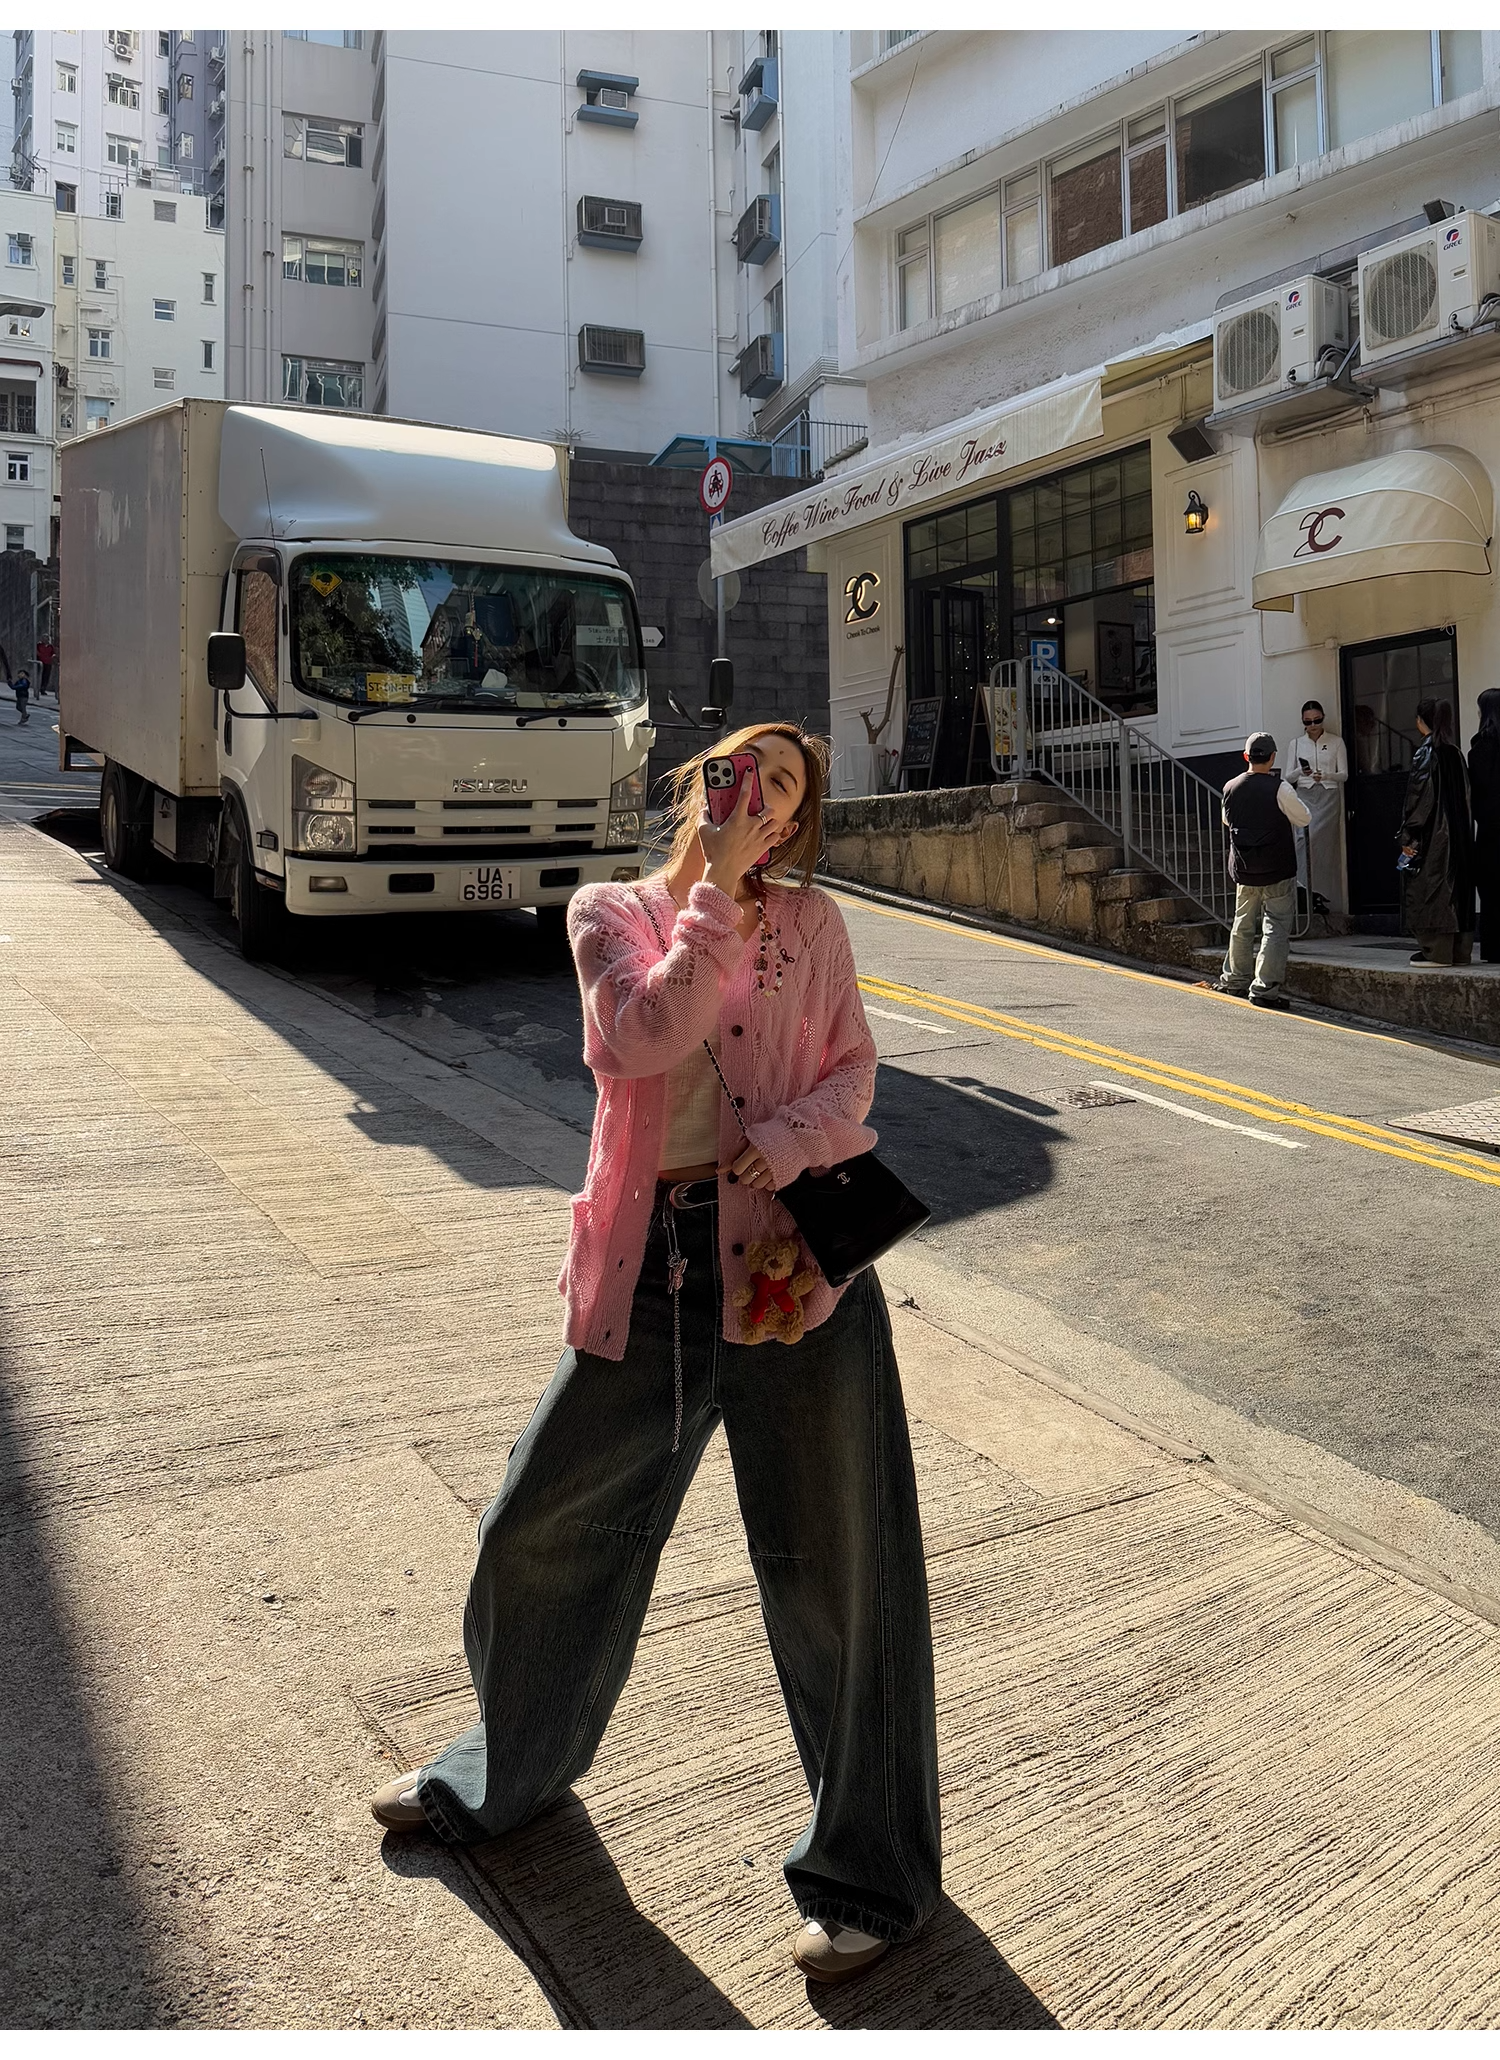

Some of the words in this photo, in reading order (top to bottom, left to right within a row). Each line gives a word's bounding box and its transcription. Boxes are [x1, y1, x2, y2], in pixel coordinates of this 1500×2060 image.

[1443, 238, 1463, 251] GREE
[1286, 300, 1303, 311] GREE
[761, 509, 800, 549] Coffee
[802, 496, 840, 531] Wine
[841, 479, 886, 516] Food
[886, 470, 904, 507] &
[908, 455, 952, 490] Live
[955, 438, 1008, 482] Jazz
[1036, 643, 1056, 667] P
[453, 779, 528, 794] ISUZU
[477, 867, 503, 884] UA
[463, 883, 513, 900] 6961
